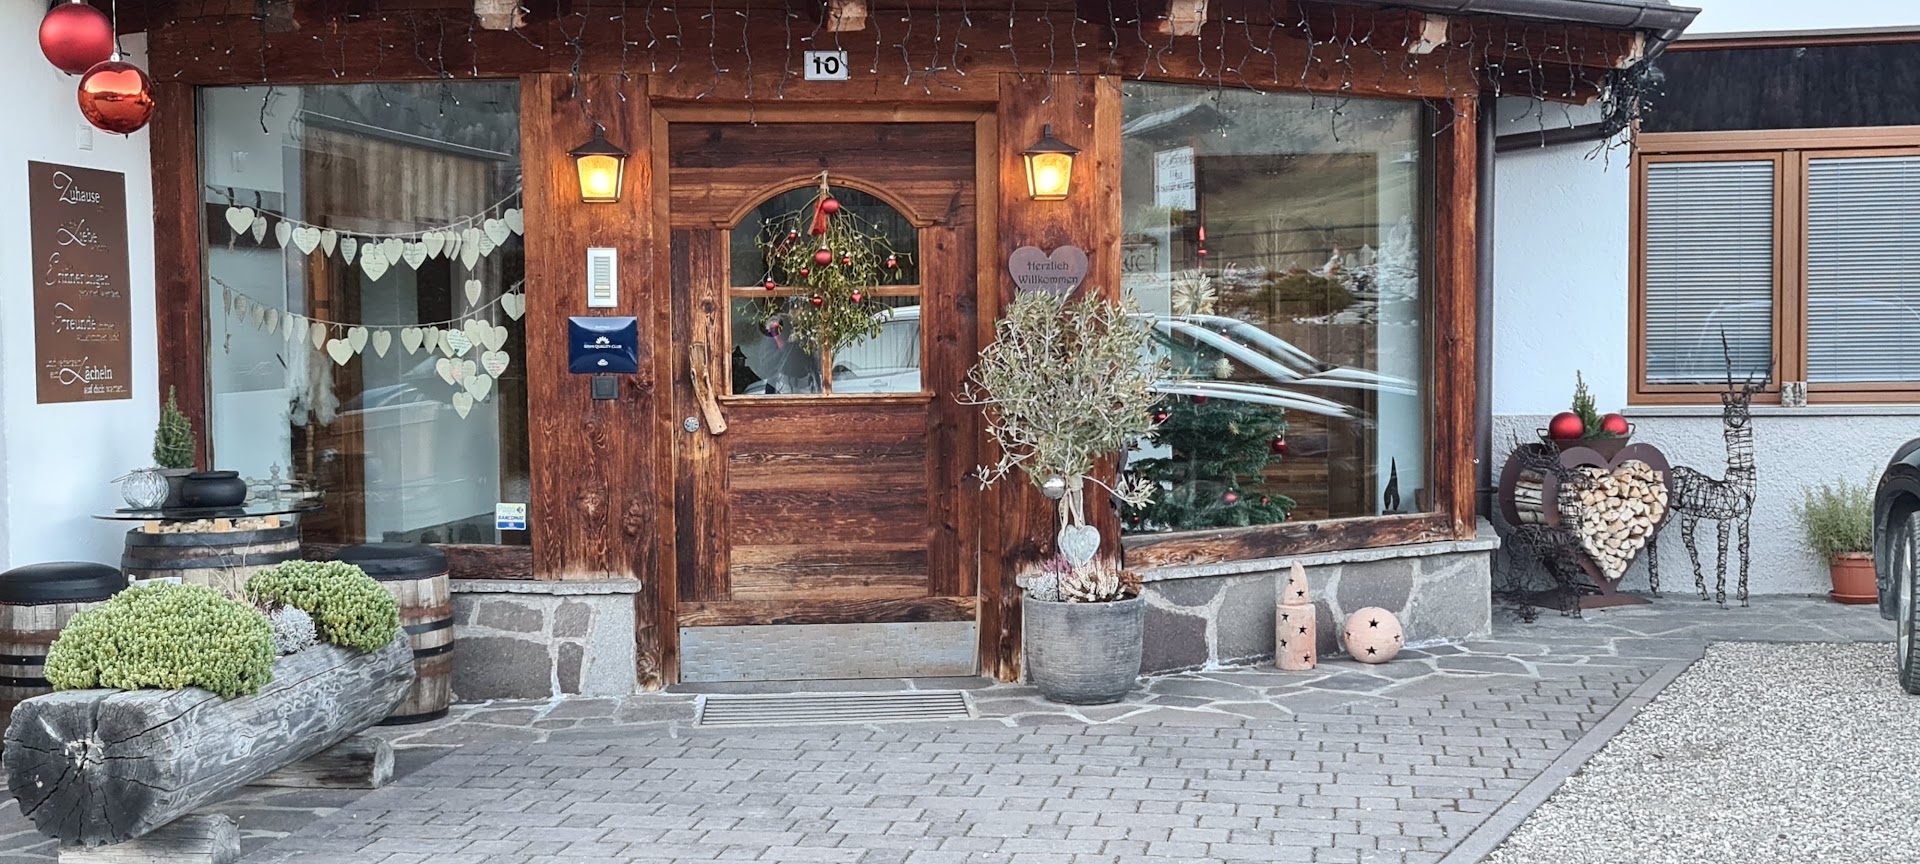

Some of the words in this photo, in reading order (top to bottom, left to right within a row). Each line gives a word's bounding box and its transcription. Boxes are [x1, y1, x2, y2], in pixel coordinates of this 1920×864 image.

[813, 56, 840, 75] 10
[52, 170, 101, 205] Zuhause
[56, 218, 98, 247] Liebe
[1018, 274, 1078, 285] Willkommen
[1026, 261, 1069, 271] Herzlich
[51, 302, 97, 334] Freunde
[59, 356, 113, 385] Lächeln
